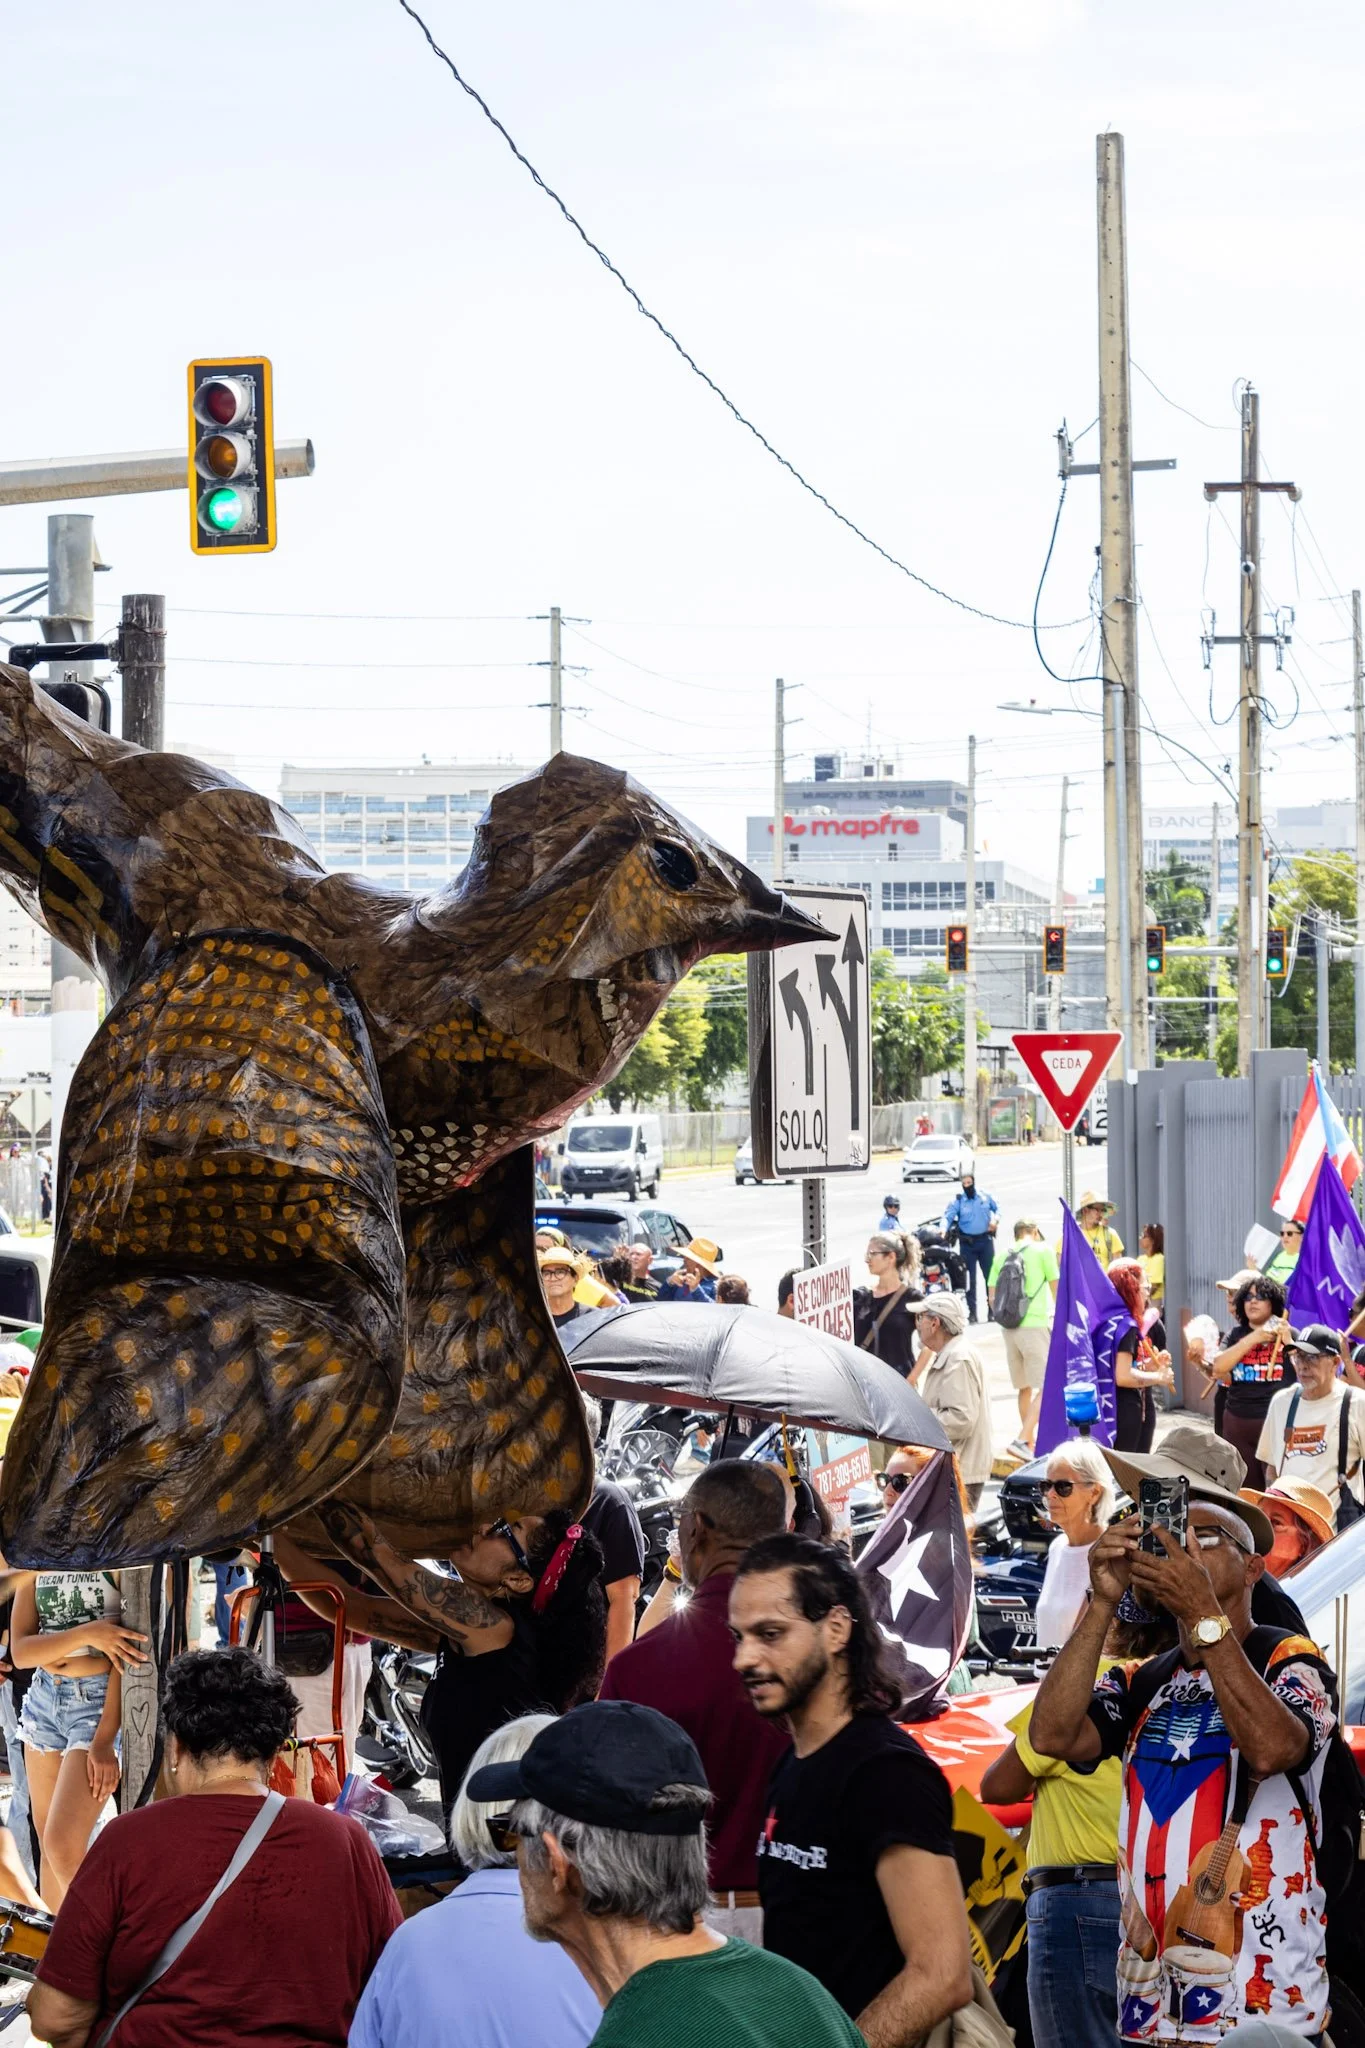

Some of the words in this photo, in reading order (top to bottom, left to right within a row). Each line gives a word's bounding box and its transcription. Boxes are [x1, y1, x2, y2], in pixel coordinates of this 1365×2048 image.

[811, 813, 920, 839] mapfre
[1052, 1057, 1082, 1069] CEDA
[780, 1109, 823, 1151] SOLO
[797, 1281, 809, 1315] SE
[811, 1265, 851, 1310] COMPRAN
[799, 1301, 852, 1342] OJES
[39, 1574, 64, 1586] DREAM
[67, 1572, 101, 1583] TUNNEL
